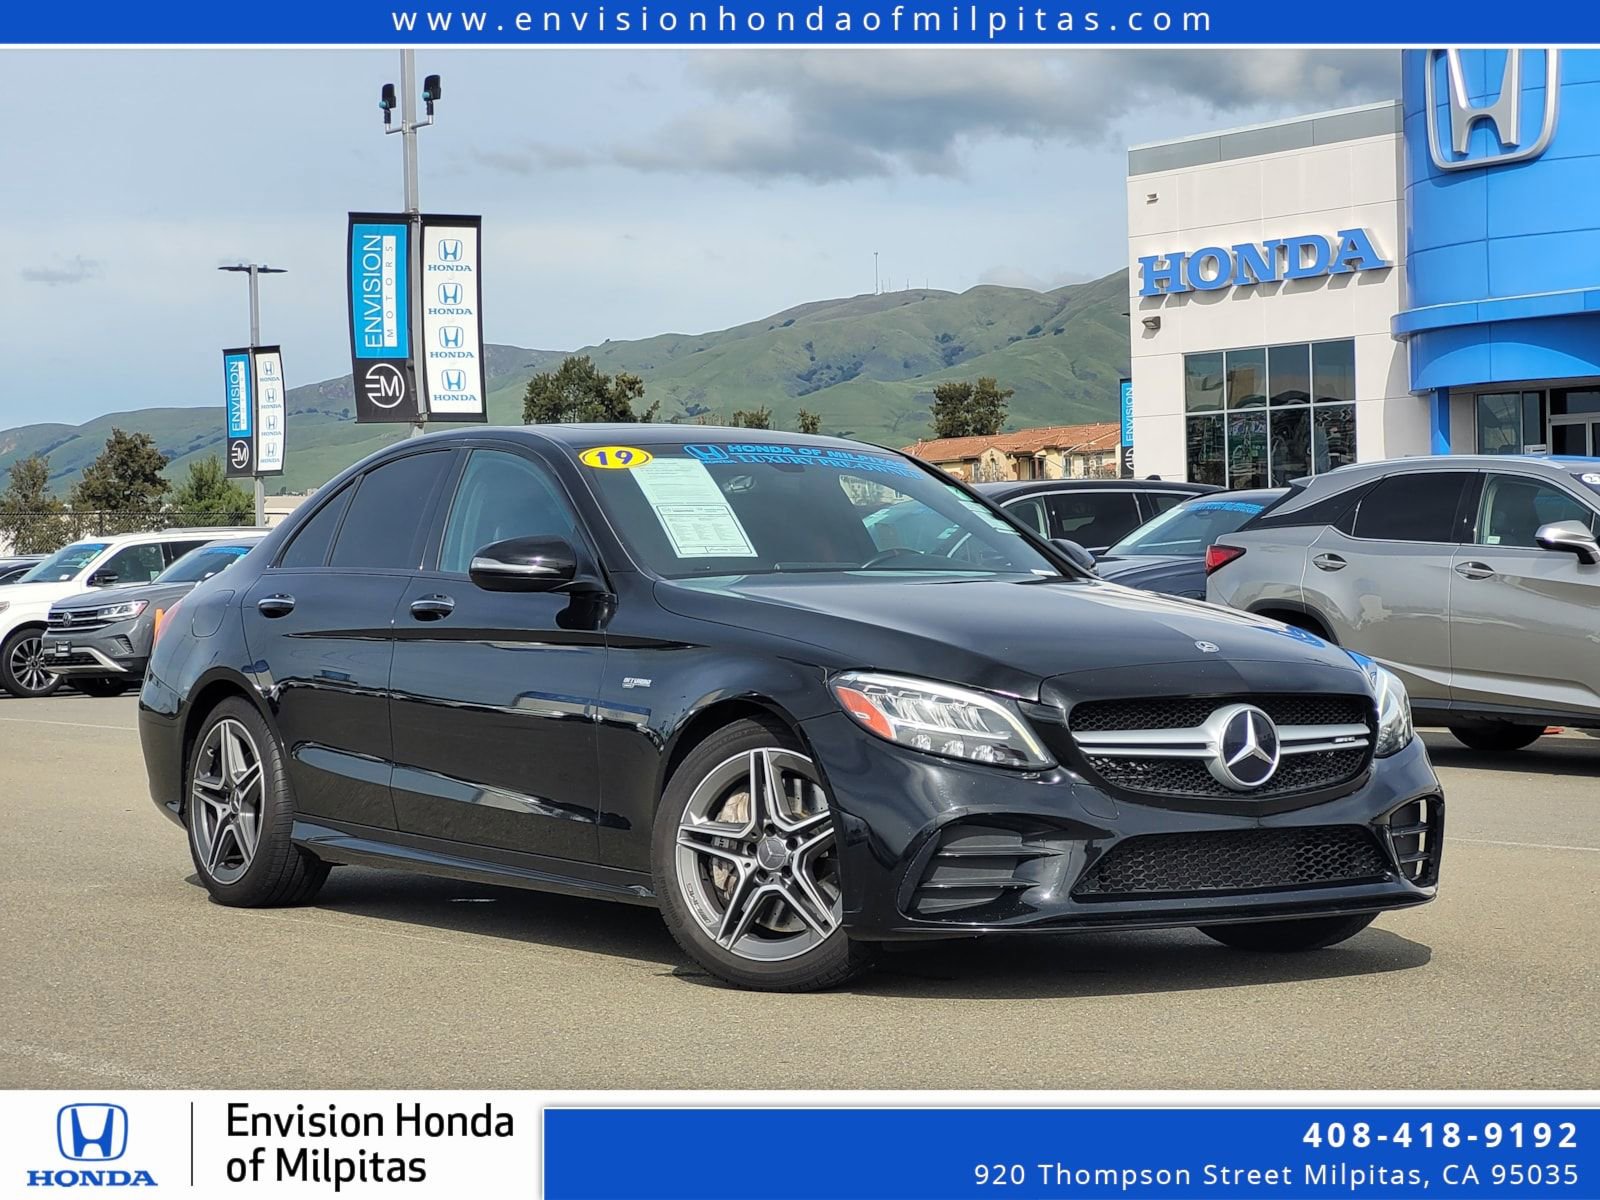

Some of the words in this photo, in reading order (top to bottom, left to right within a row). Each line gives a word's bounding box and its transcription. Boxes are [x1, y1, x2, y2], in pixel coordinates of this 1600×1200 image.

[428, 264, 472, 272] HONDA
[1138, 228, 1387, 296] HONDA
[363, 235, 383, 348] ENVISION
[385, 245, 394, 338] MOTORS
[428, 307, 473, 315] HONDA
[430, 351, 474, 359] HONDA
[230, 361, 241, 432] ENVISION
[433, 393, 477, 401] HONDA
[1125, 387, 1134, 442] ENVISION
[727, 444, 795, 454] HONDA
[799, 448, 821, 456] OF
[596, 450, 633, 465] 19
[736, 455, 814, 465] LUXURY
